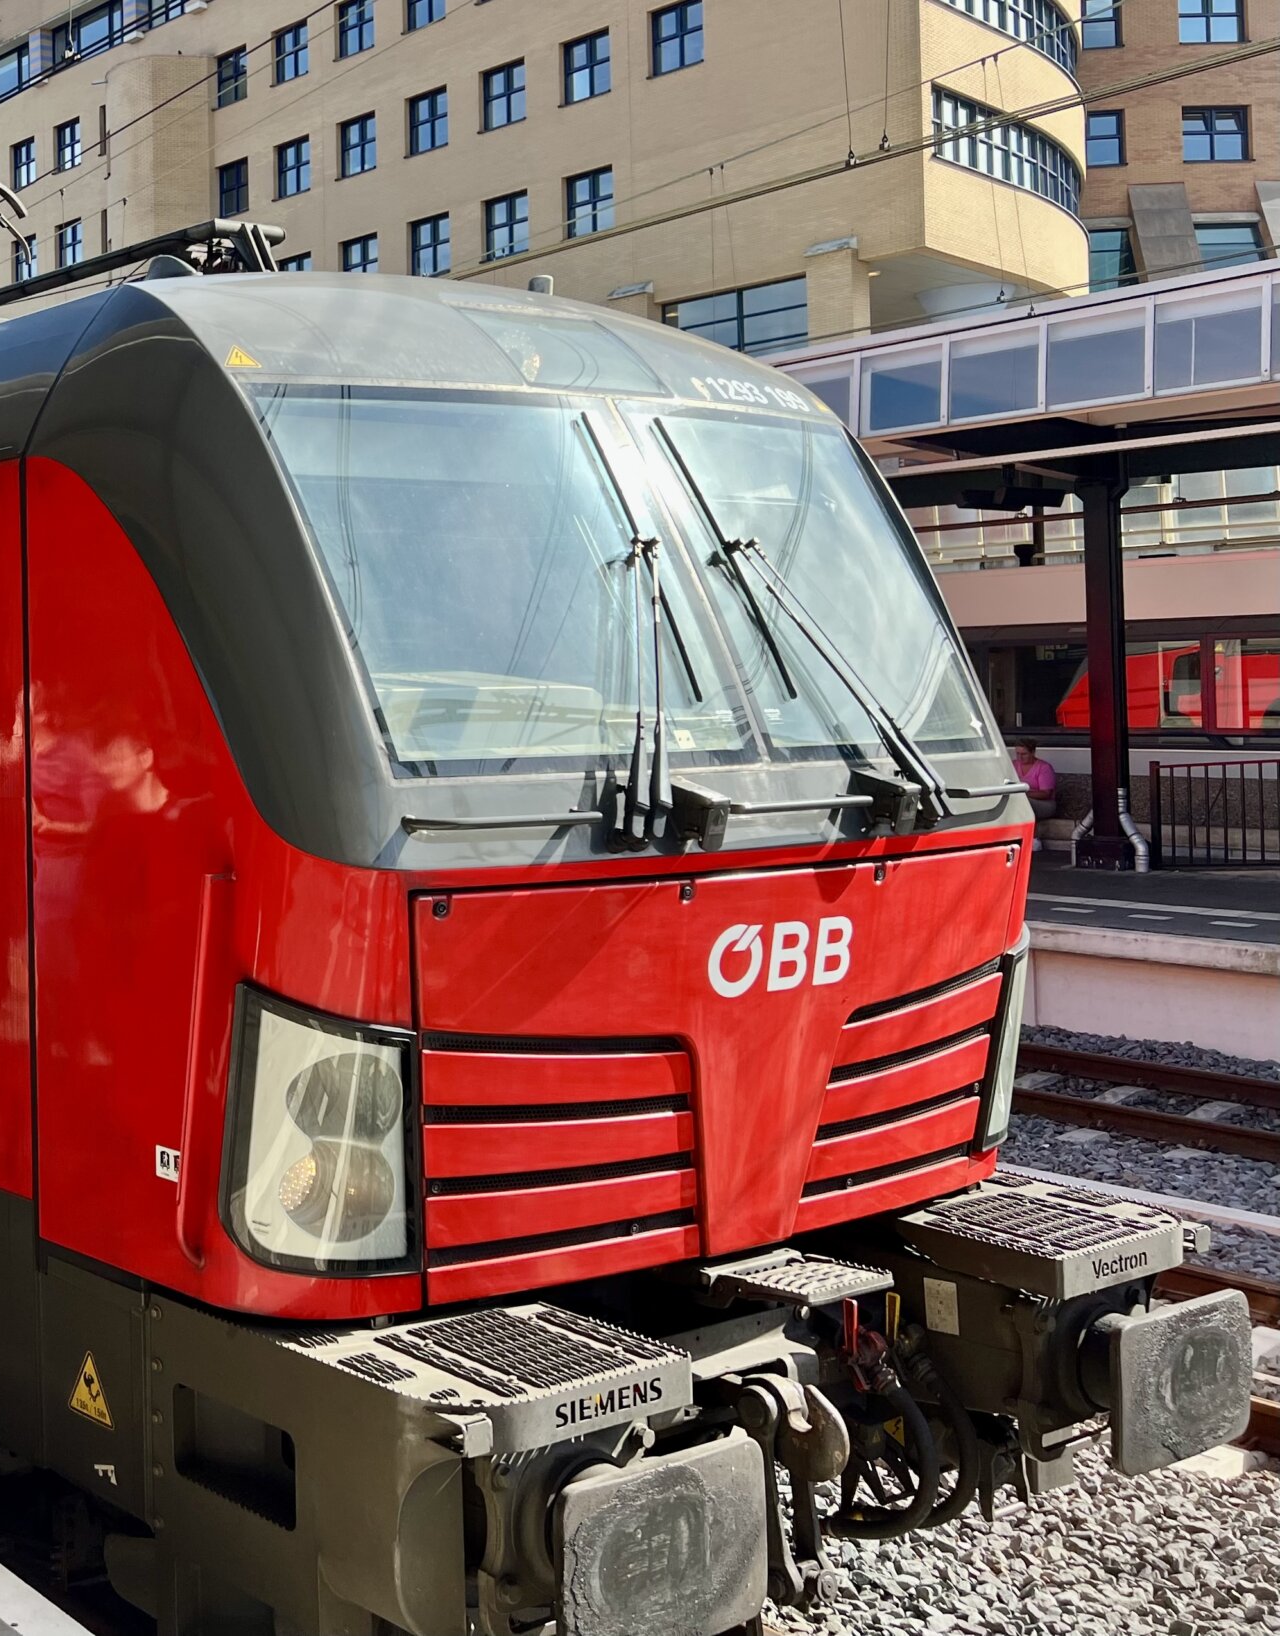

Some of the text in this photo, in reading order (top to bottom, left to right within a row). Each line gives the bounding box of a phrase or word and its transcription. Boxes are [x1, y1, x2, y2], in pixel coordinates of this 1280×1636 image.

[705, 377, 810, 412] 1293 199
[708, 916, 853, 998] ÖBB
[1092, 1250, 1148, 1279] Vectron
[554, 1377, 663, 1429] SIEMENS
